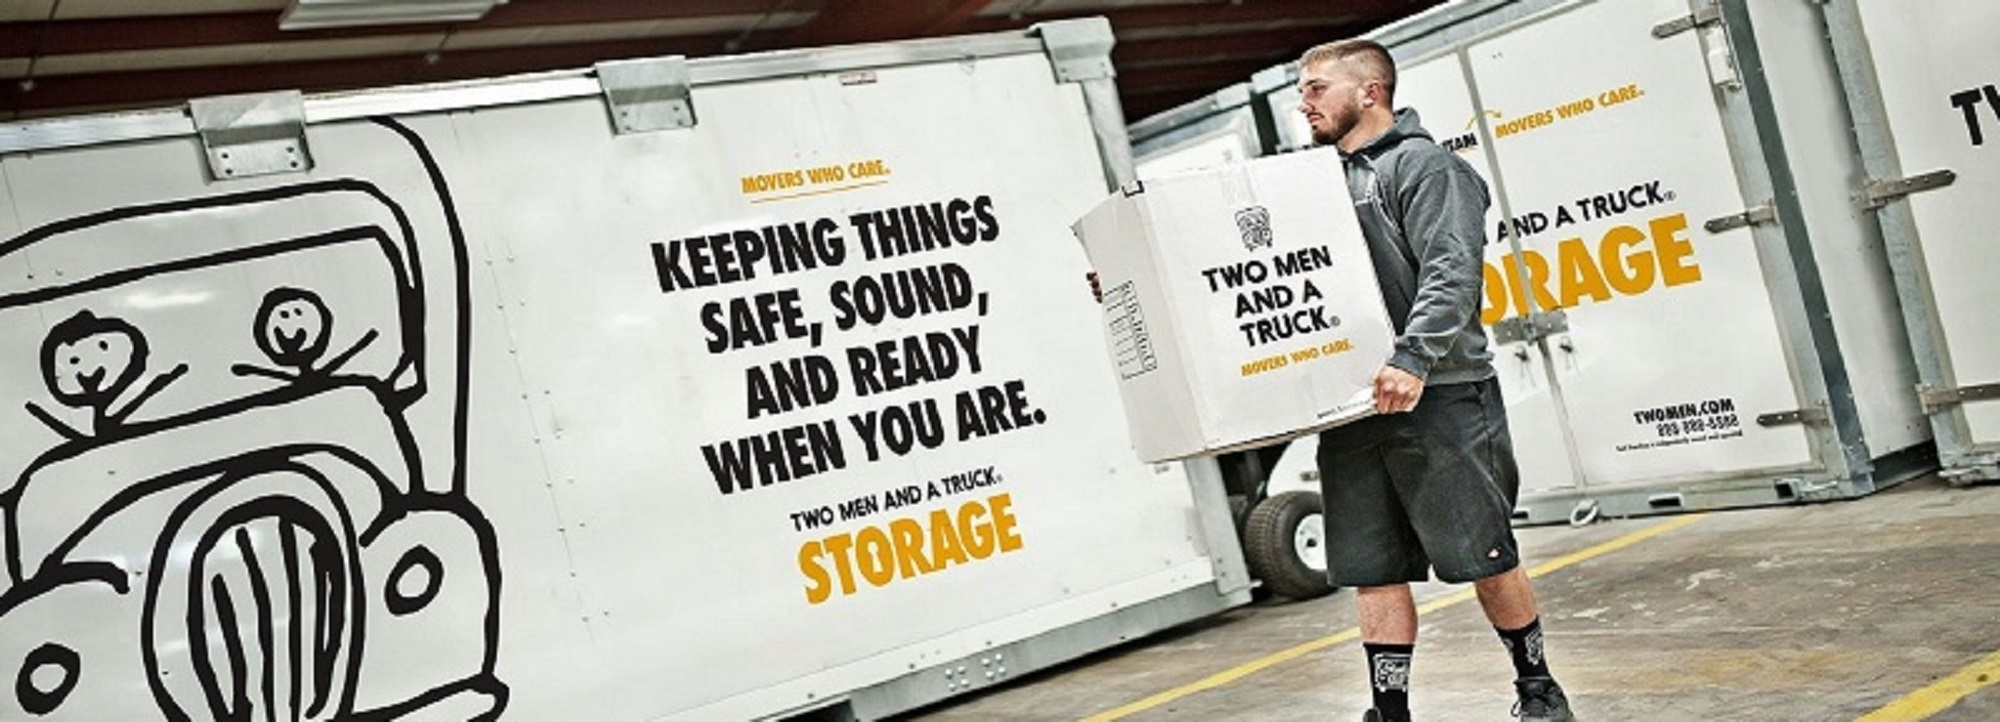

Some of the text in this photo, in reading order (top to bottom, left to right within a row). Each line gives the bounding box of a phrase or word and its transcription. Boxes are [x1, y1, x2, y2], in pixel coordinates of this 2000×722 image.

[1495, 111, 1554, 138] MOVERS
[1556, 98, 1594, 120] WHO
[741, 170, 805, 194] MOVERS
[806, 163, 844, 184] WHO
[651, 196, 1000, 293] KEEPING THINGS
[1497, 212, 1549, 242] AND
[1555, 205, 1576, 228] A
[1202, 245, 1333, 292] TWO MEN
[701, 263, 989, 354] SAFE, SOUND,
[1235, 279, 1323, 318] AND A
[745, 325, 982, 420] AND READY
[1241, 356, 1289, 377] MOVERS
[1290, 347, 1321, 363] WHO
[1634, 398, 1735, 424] TWOMEN.COM
[701, 379, 1047, 495] WHEN YOU ARE.
[790, 506, 835, 531] TWO
[838, 494, 880, 520] MEN
[884, 484, 922, 510] AND
[926, 480, 942, 500] A
[798, 493, 1023, 605] STORAGE
